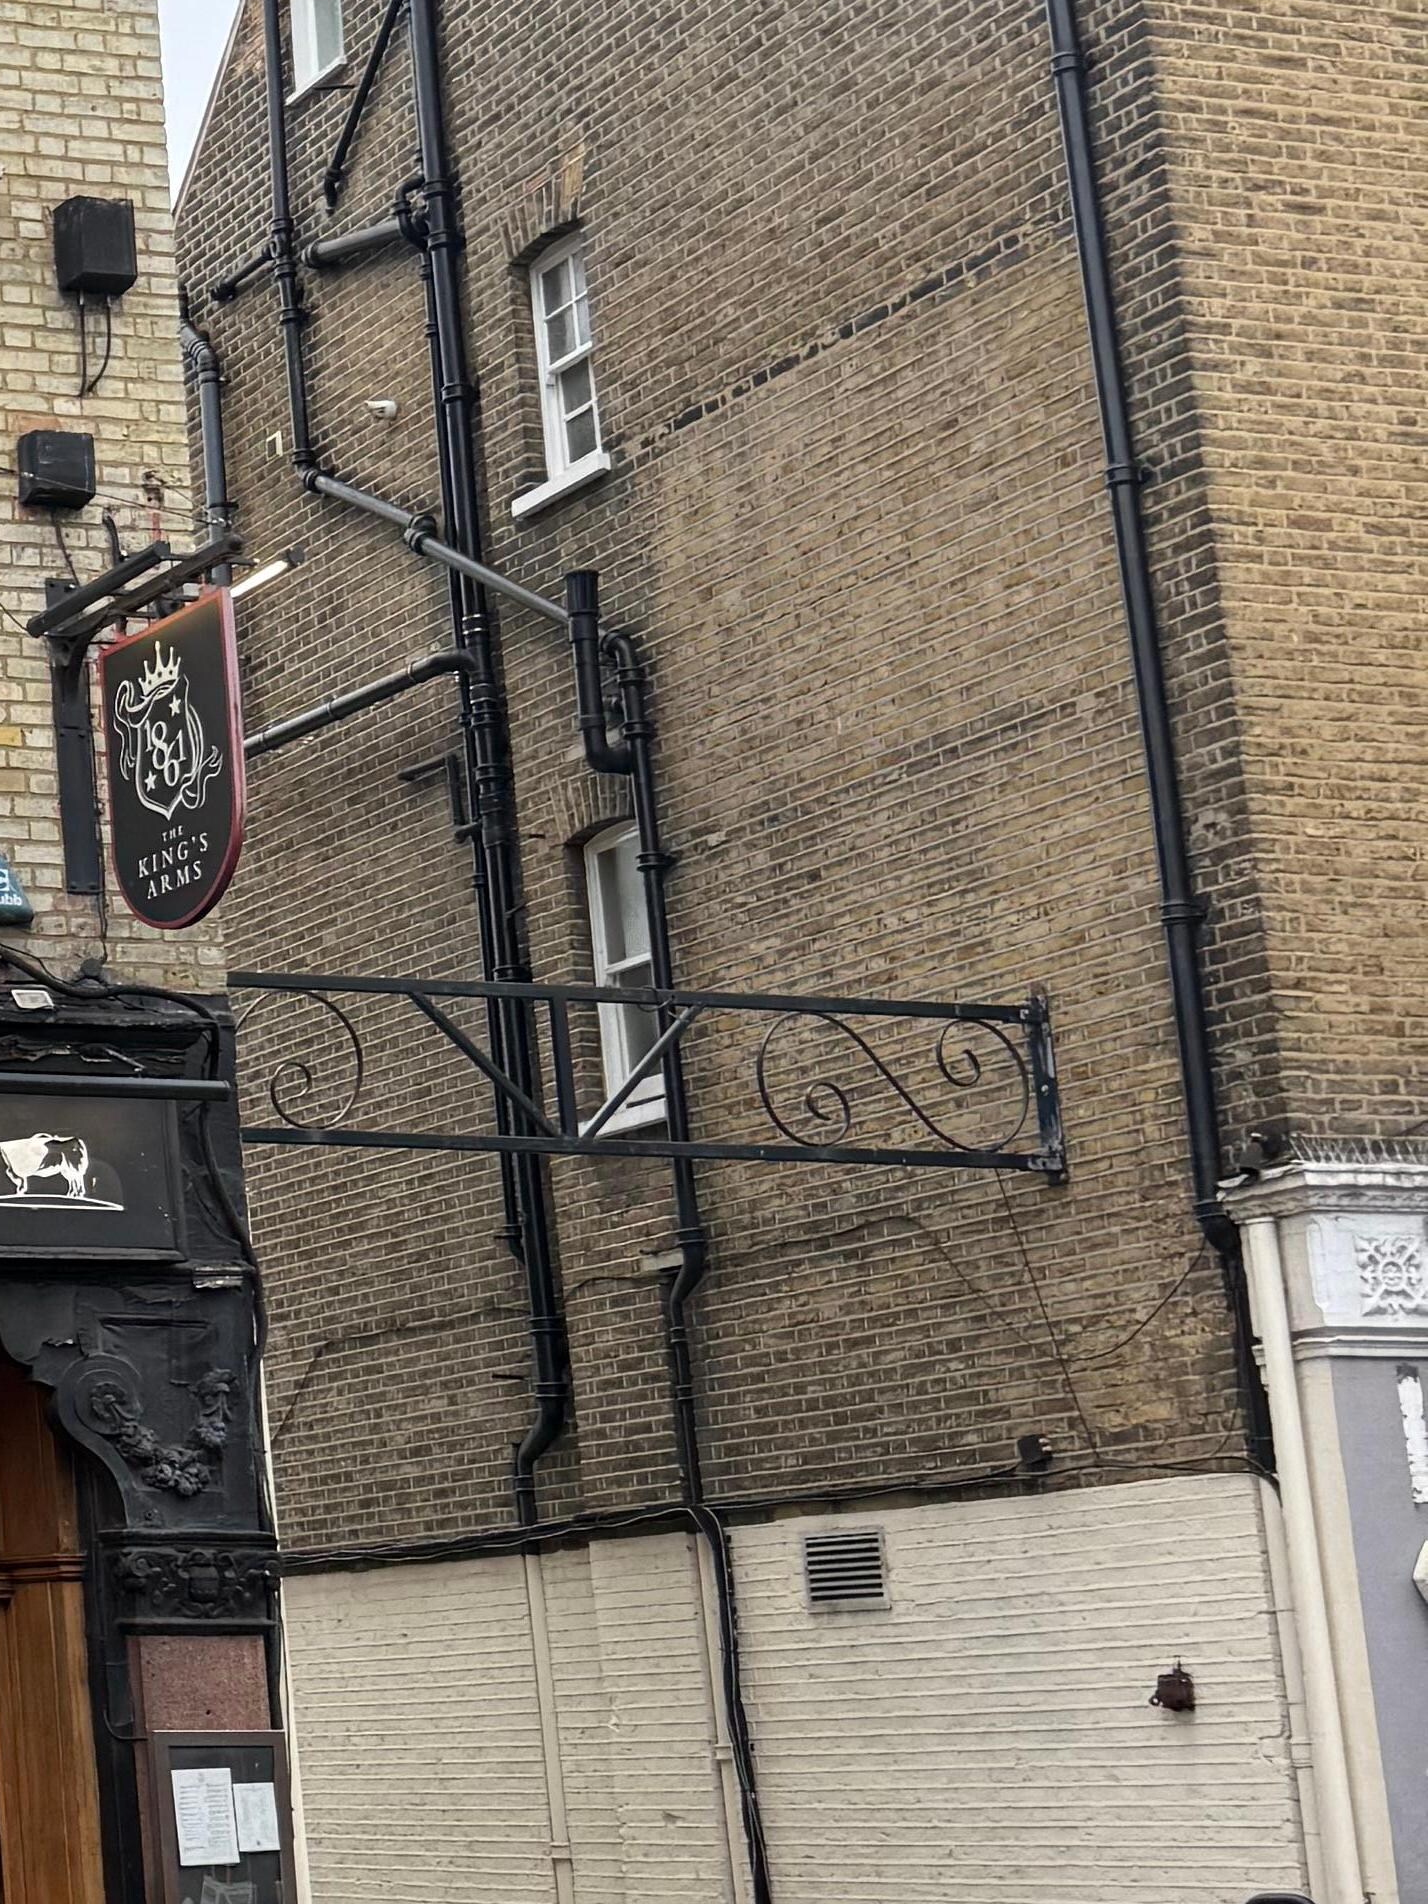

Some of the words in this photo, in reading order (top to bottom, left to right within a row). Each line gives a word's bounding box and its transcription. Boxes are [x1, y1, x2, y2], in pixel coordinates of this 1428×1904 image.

[145, 719, 187, 787] 1861
[162, 825, 184, 842] THE
[138, 832, 209, 878] KING'S
[147, 861, 202, 899] ARMS
